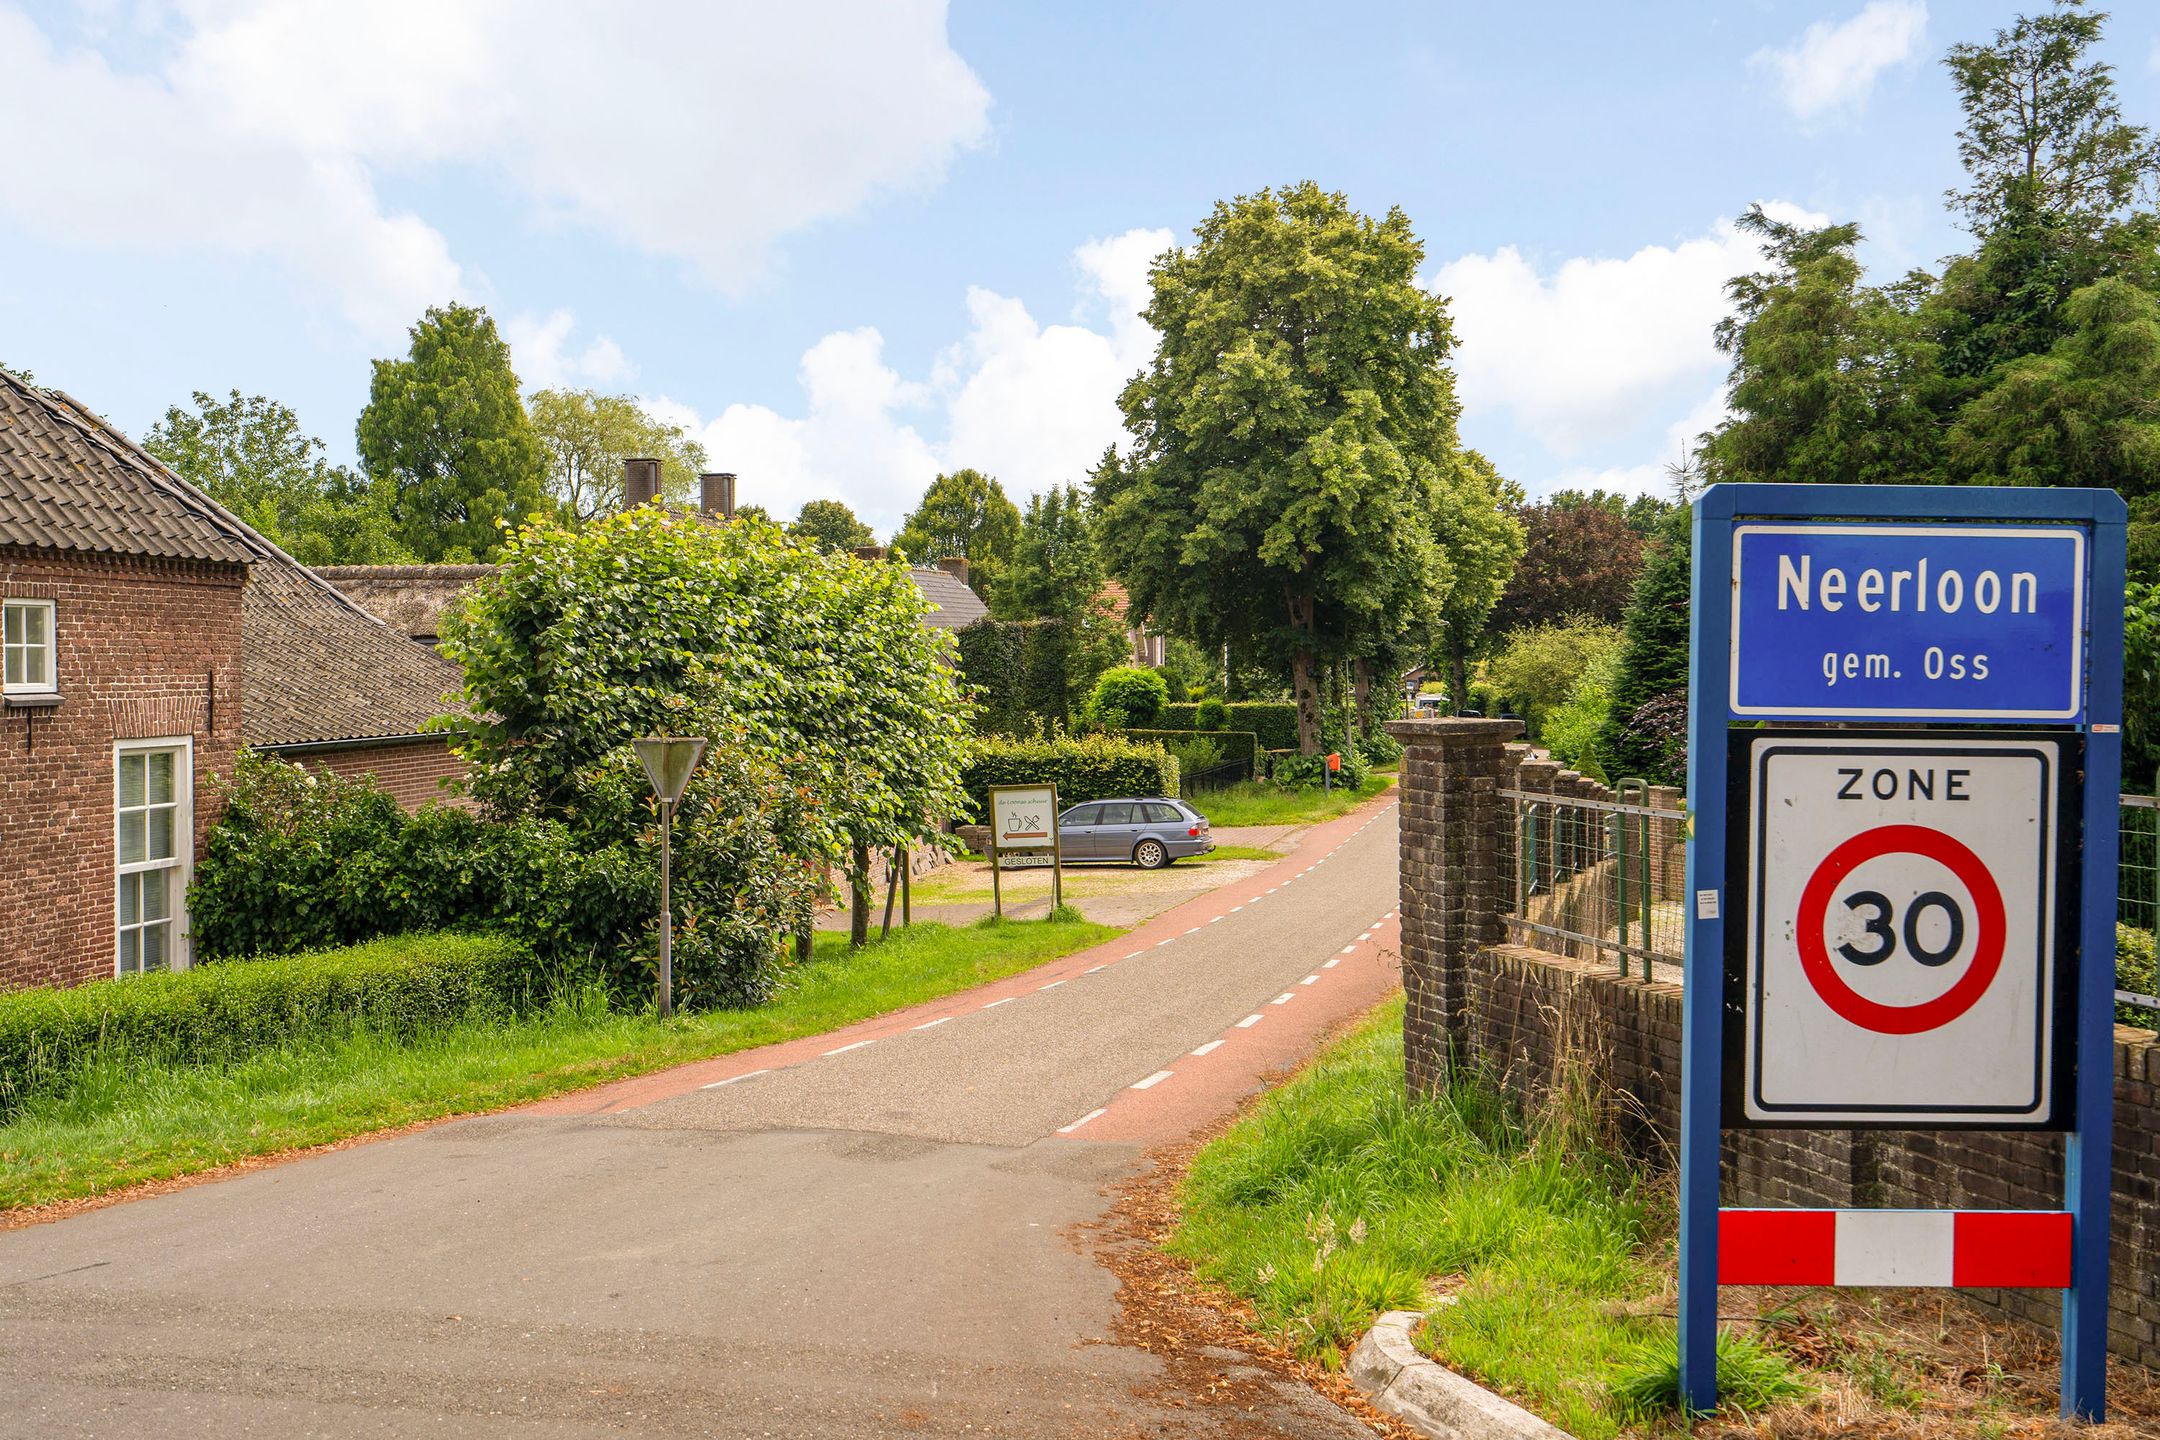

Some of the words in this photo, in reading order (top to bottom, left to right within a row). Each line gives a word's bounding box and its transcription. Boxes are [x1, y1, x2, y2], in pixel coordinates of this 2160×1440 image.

[1777, 554, 2037, 614] Neerloon
[1823, 651, 1902, 687] gem.
[1923, 647, 1990, 680] Oss
[1837, 768, 1971, 801] ZONE
[1004, 857, 1049, 866] GESLOTEN
[1837, 891, 1965, 967] 30
